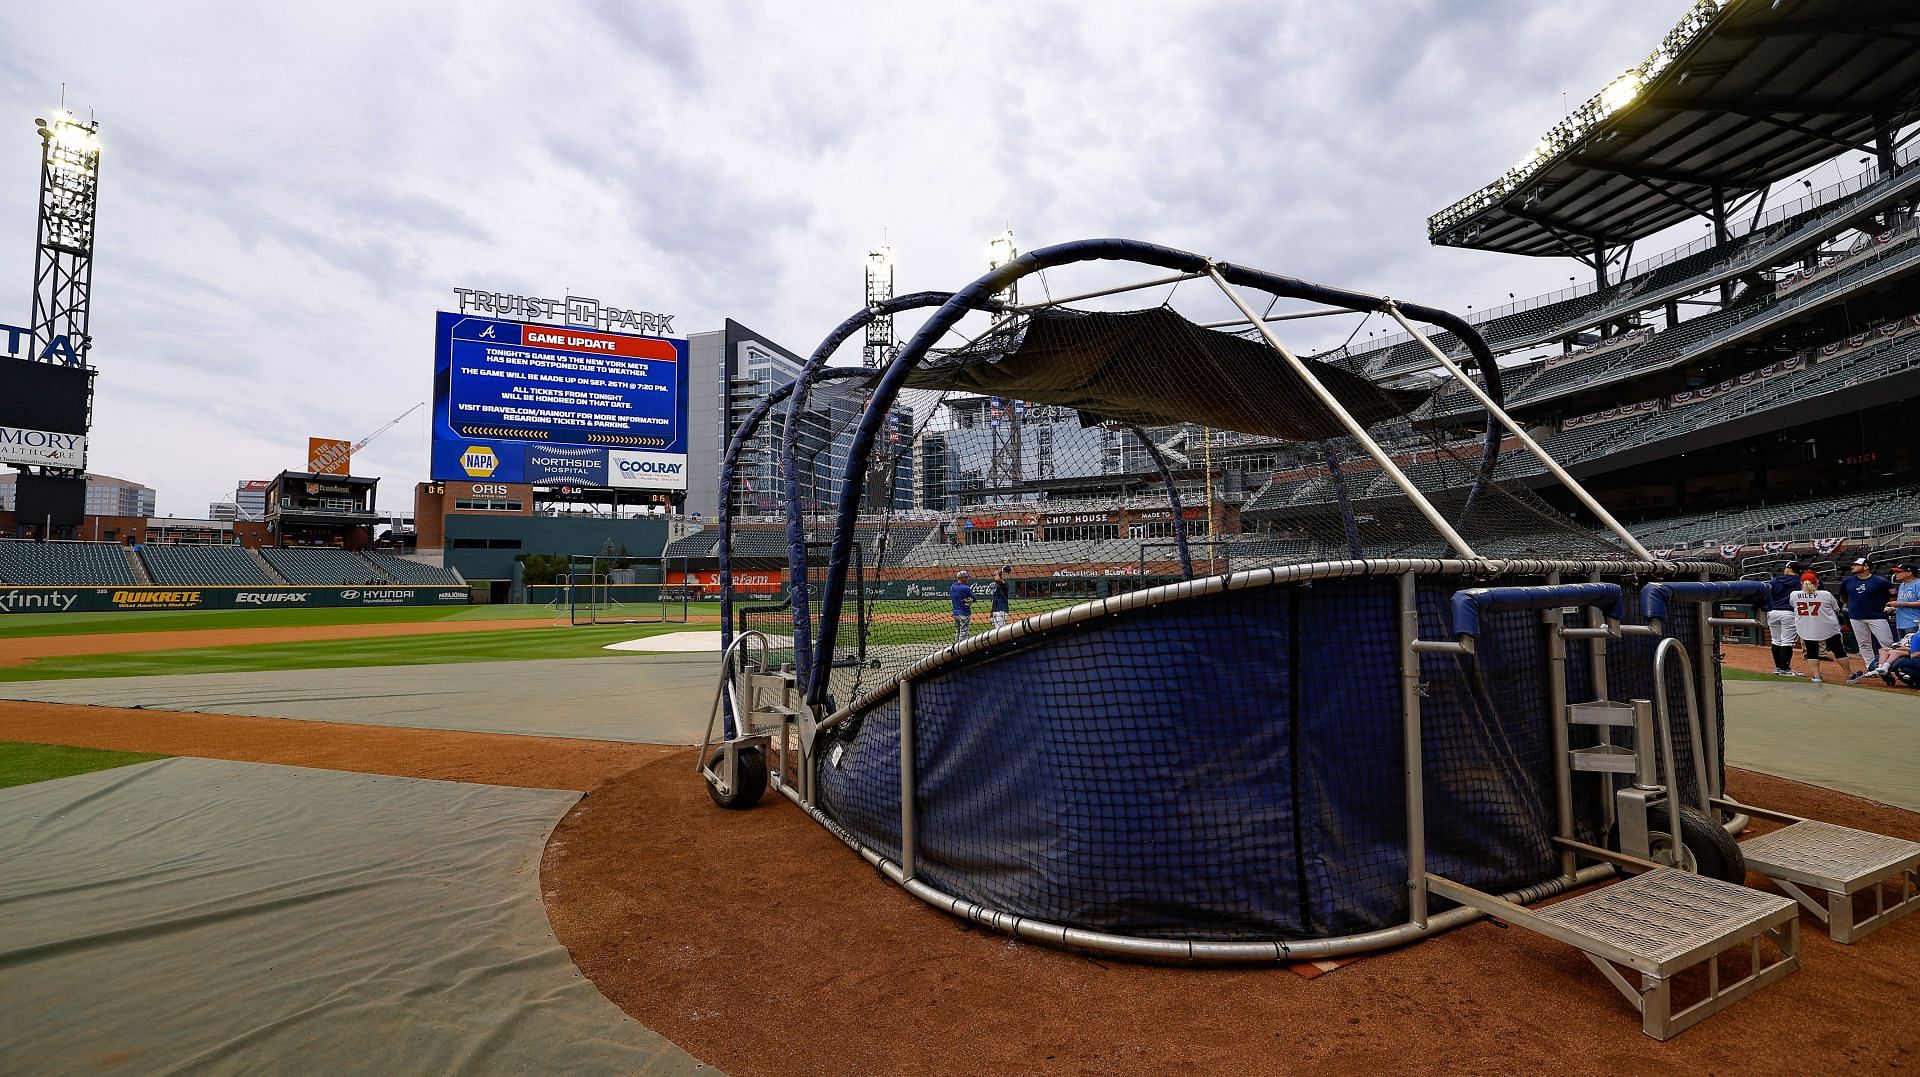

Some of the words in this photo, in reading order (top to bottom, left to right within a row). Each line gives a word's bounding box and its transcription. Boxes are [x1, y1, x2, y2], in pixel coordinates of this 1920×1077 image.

[454, 287, 559, 319] TRUIST
[606, 306, 675, 333] PARK
[528, 332, 565, 345] GAME
[567, 336, 616, 351] UPDATE
[486, 348, 531, 358] TONIGHT'S
[531, 352, 556, 360] GAME
[586, 358, 605, 366] NEW
[605, 360, 627, 368] YORK
[628, 362, 649, 370] METS
[506, 357, 528, 365] BEEN
[530, 360, 578, 370] POSTPONED
[579, 364, 596, 372] DUE
[608, 367, 648, 377] WEATHER.
[461, 367, 479, 375] THE
[480, 369, 505, 377] GAME
[506, 371, 527, 379] WILL
[540, 374, 564, 382] MADE
[590, 379, 607, 387] SEP.
[608, 380, 628, 388] 26TH
[501, 392, 522, 400] WILL
[536, 396, 575, 404] HONORED
[576, 398, 588, 406] ON
[589, 399, 610, 408] THAT
[529, 387, 564, 396] TICKETS
[564, 390, 588, 398] FROM
[589, 392, 624, 402] TONIGHT
[458, 403, 482, 411] VISIT
[482, 405, 576, 418] BRAVES.COM/RAINOUT
[576, 412, 592, 420] FOR
[618, 415, 669, 425] INFORMATION
[503, 414, 552, 424] REGARDING
[552, 418, 586, 426] TICKETS
[594, 420, 630, 429] PARKING.
[313, 442, 331, 456] THE
[20, 458, 52, 466] Healthcare
[309, 442, 350, 472] HOME
[325, 453, 349, 473] DEPOT
[466, 454, 493, 469] NAPA
[532, 457, 602, 468] NORTHSIDE
[544, 467, 589, 475] HOSPITAL
[619, 460, 683, 474] COOLRAY
[428, 486, 444, 494] 0:15
[472, 483, 508, 494] ORIS
[652, 494, 665, 502] 0:15
[996, 519, 1018, 527] LIGHT
[1046, 516, 1072, 524] CHOP
[1075, 514, 1108, 523] HOUSE
[112, 591, 201, 603] QUIKRETE
[235, 592, 307, 605] EQUIFAX
[363, 590, 414, 599] HYUNDAI
[1796, 601, 1821, 616] 27
